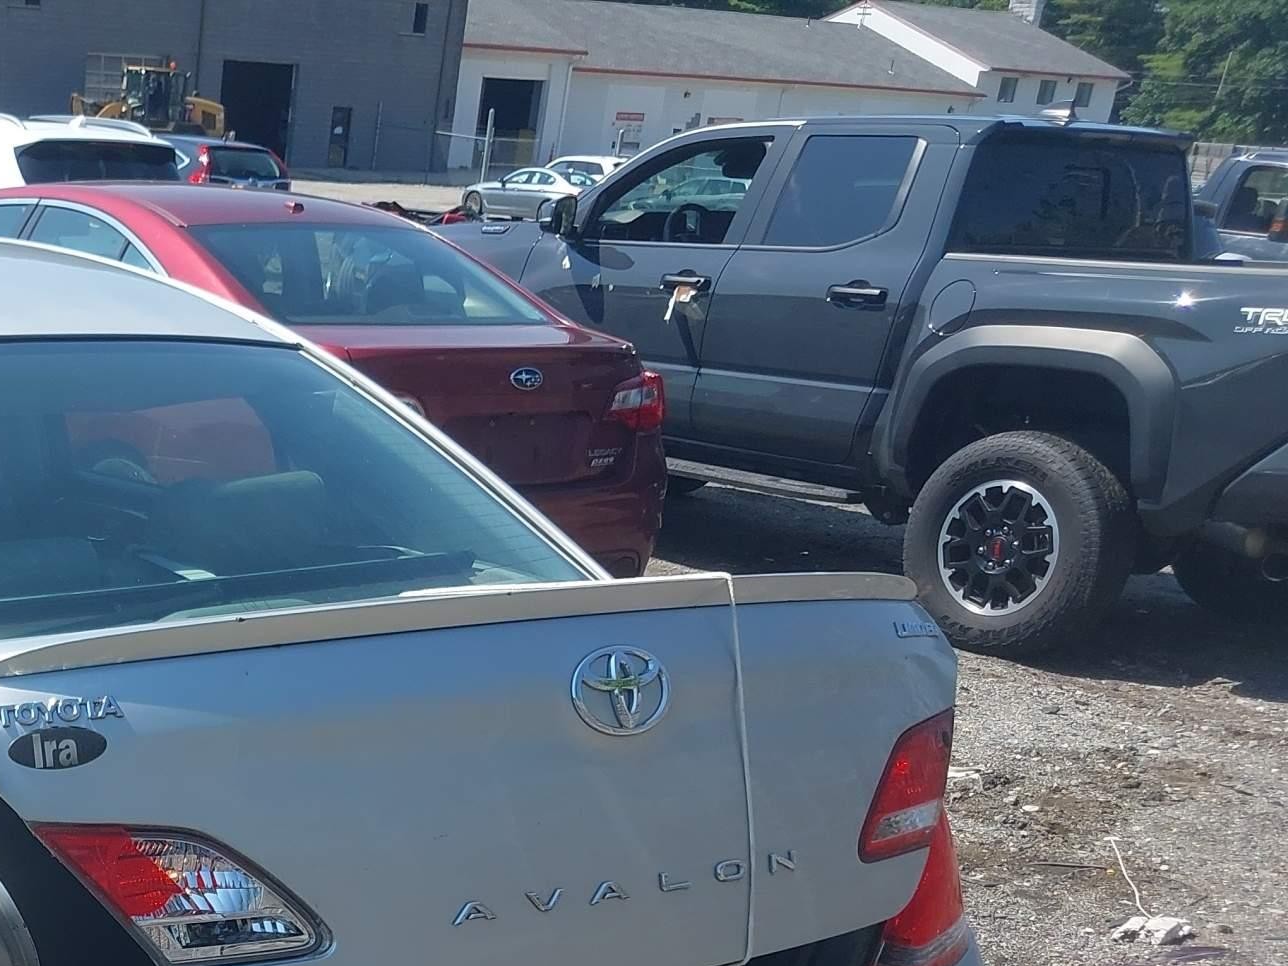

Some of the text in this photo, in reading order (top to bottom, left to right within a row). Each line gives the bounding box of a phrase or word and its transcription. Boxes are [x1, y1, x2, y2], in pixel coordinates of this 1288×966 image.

[1240, 307, 1288, 325] TR
[32, 733, 79, 769] Ira
[451, 851, 797, 926] AVALON
